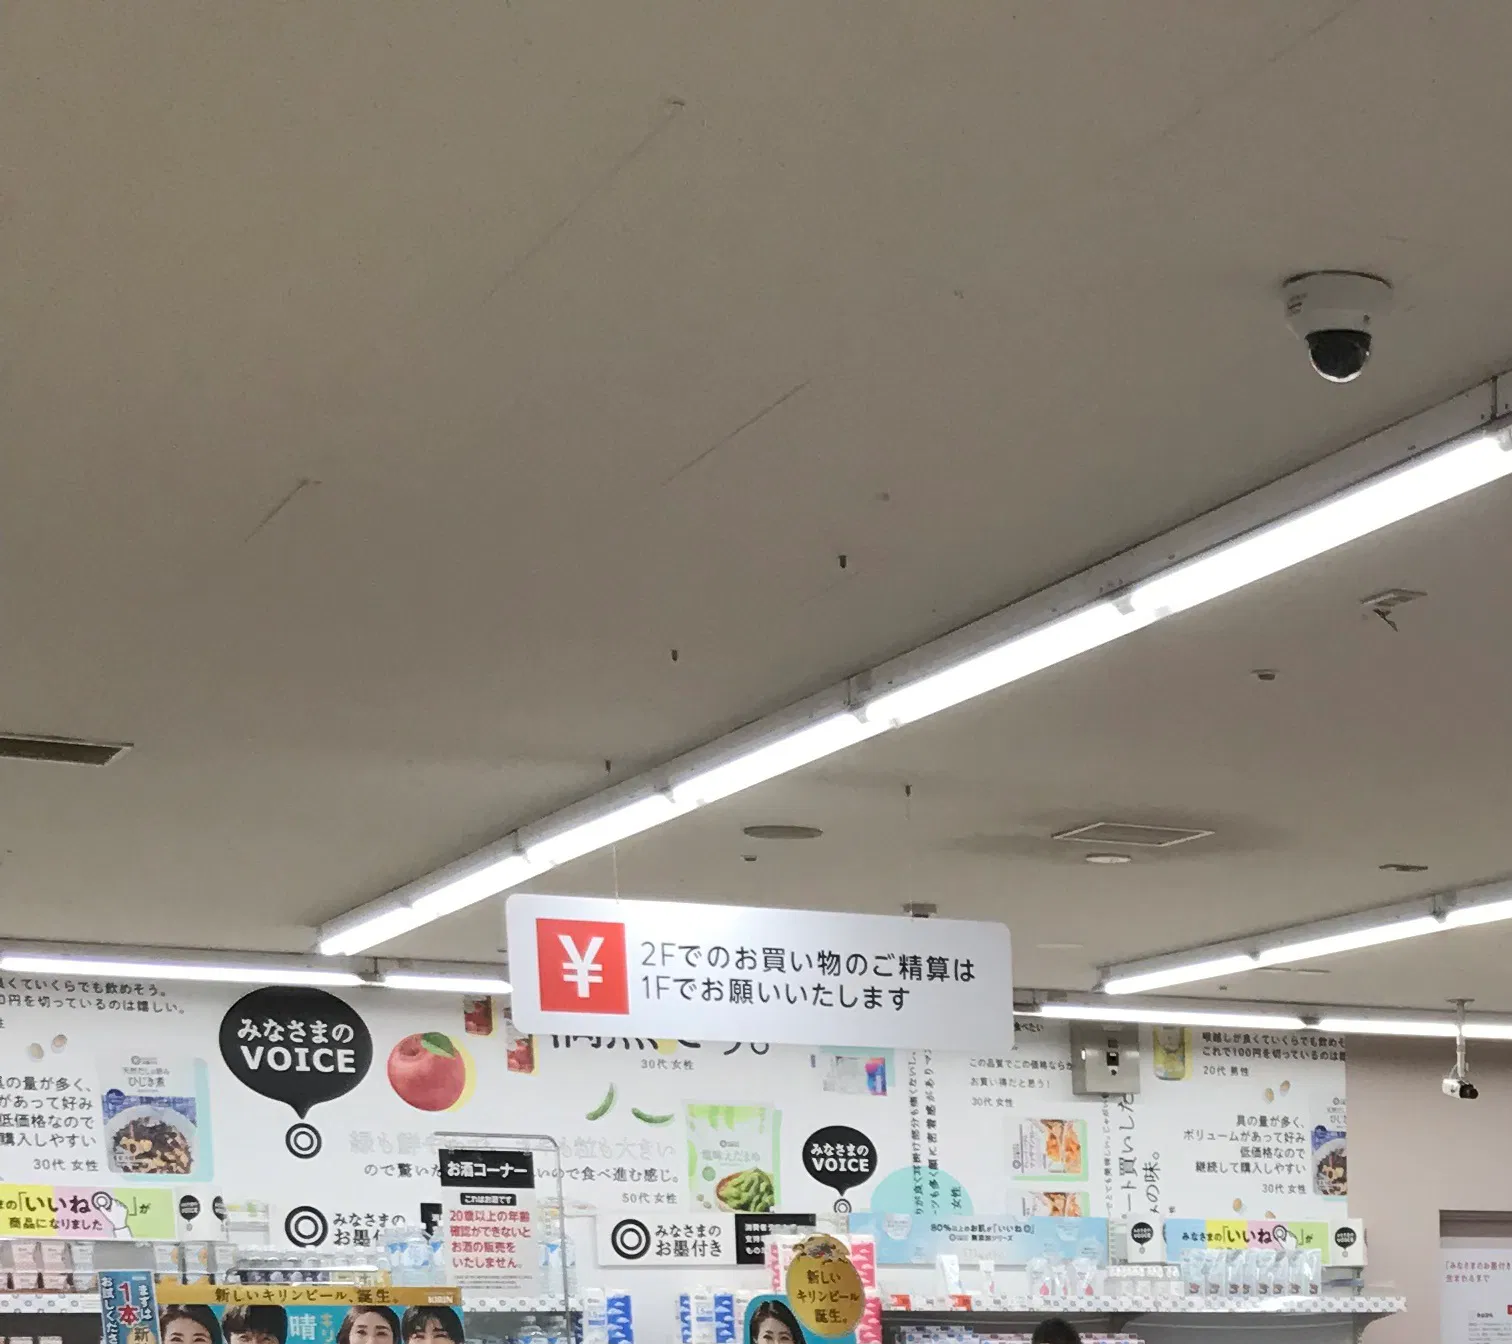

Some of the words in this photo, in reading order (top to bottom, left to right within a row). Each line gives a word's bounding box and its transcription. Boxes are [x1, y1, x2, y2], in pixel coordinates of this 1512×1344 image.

[641, 941, 976, 984] 2Fでのお買い物のご精算は
[642, 975, 911, 1012] 1Fでお願いいたします
[237, 1018, 356, 1044] みなさまの
[240, 1046, 357, 1075] VOICE
[811, 1142, 869, 1157] みなさまの
[33, 1159, 65, 1171] 30代
[446, 1161, 528, 1179] お酒コーナー
[812, 1157, 870, 1173] VOICE
[333, 1213, 406, 1227] みなさまの
[655, 1224, 721, 1238] みなさまの
[656, 1241, 722, 1258] お墨付き
